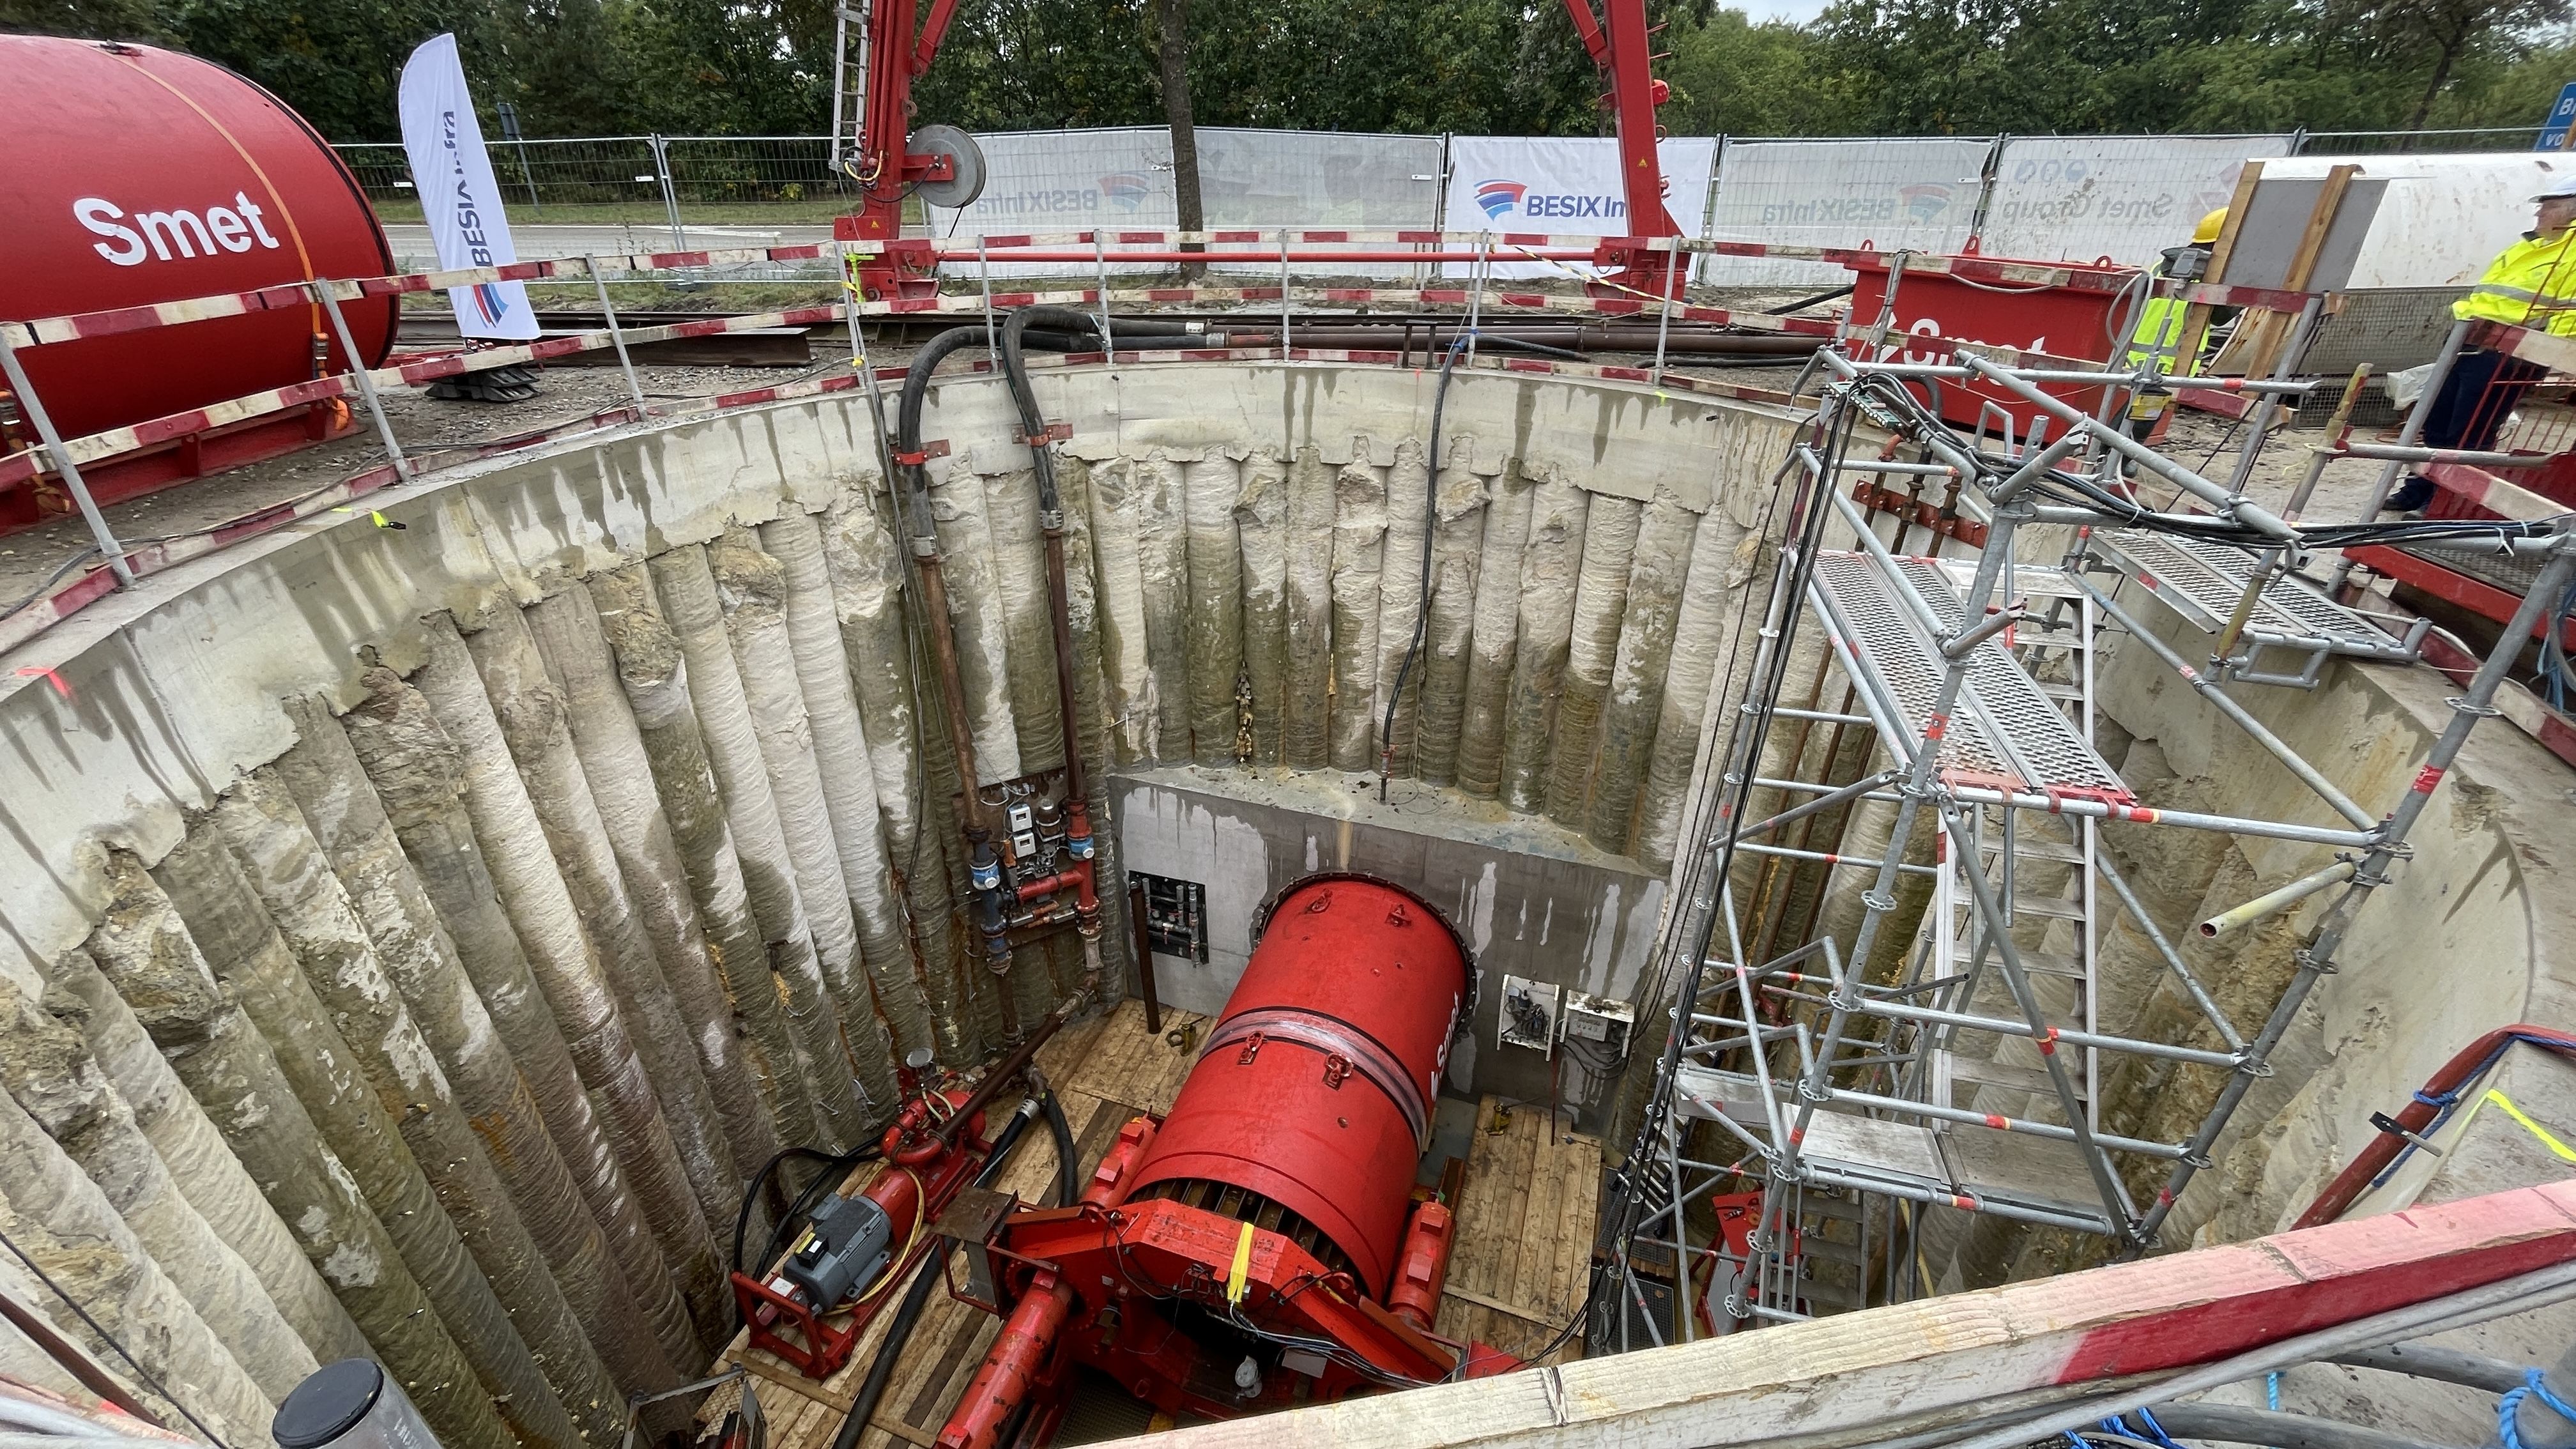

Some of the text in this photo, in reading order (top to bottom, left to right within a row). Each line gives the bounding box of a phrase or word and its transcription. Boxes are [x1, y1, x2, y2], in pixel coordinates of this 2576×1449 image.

[2545, 133, 2565, 146] vo
[1526, 195, 1626, 217] BESIX In
[73, 191, 280, 266] Smet
